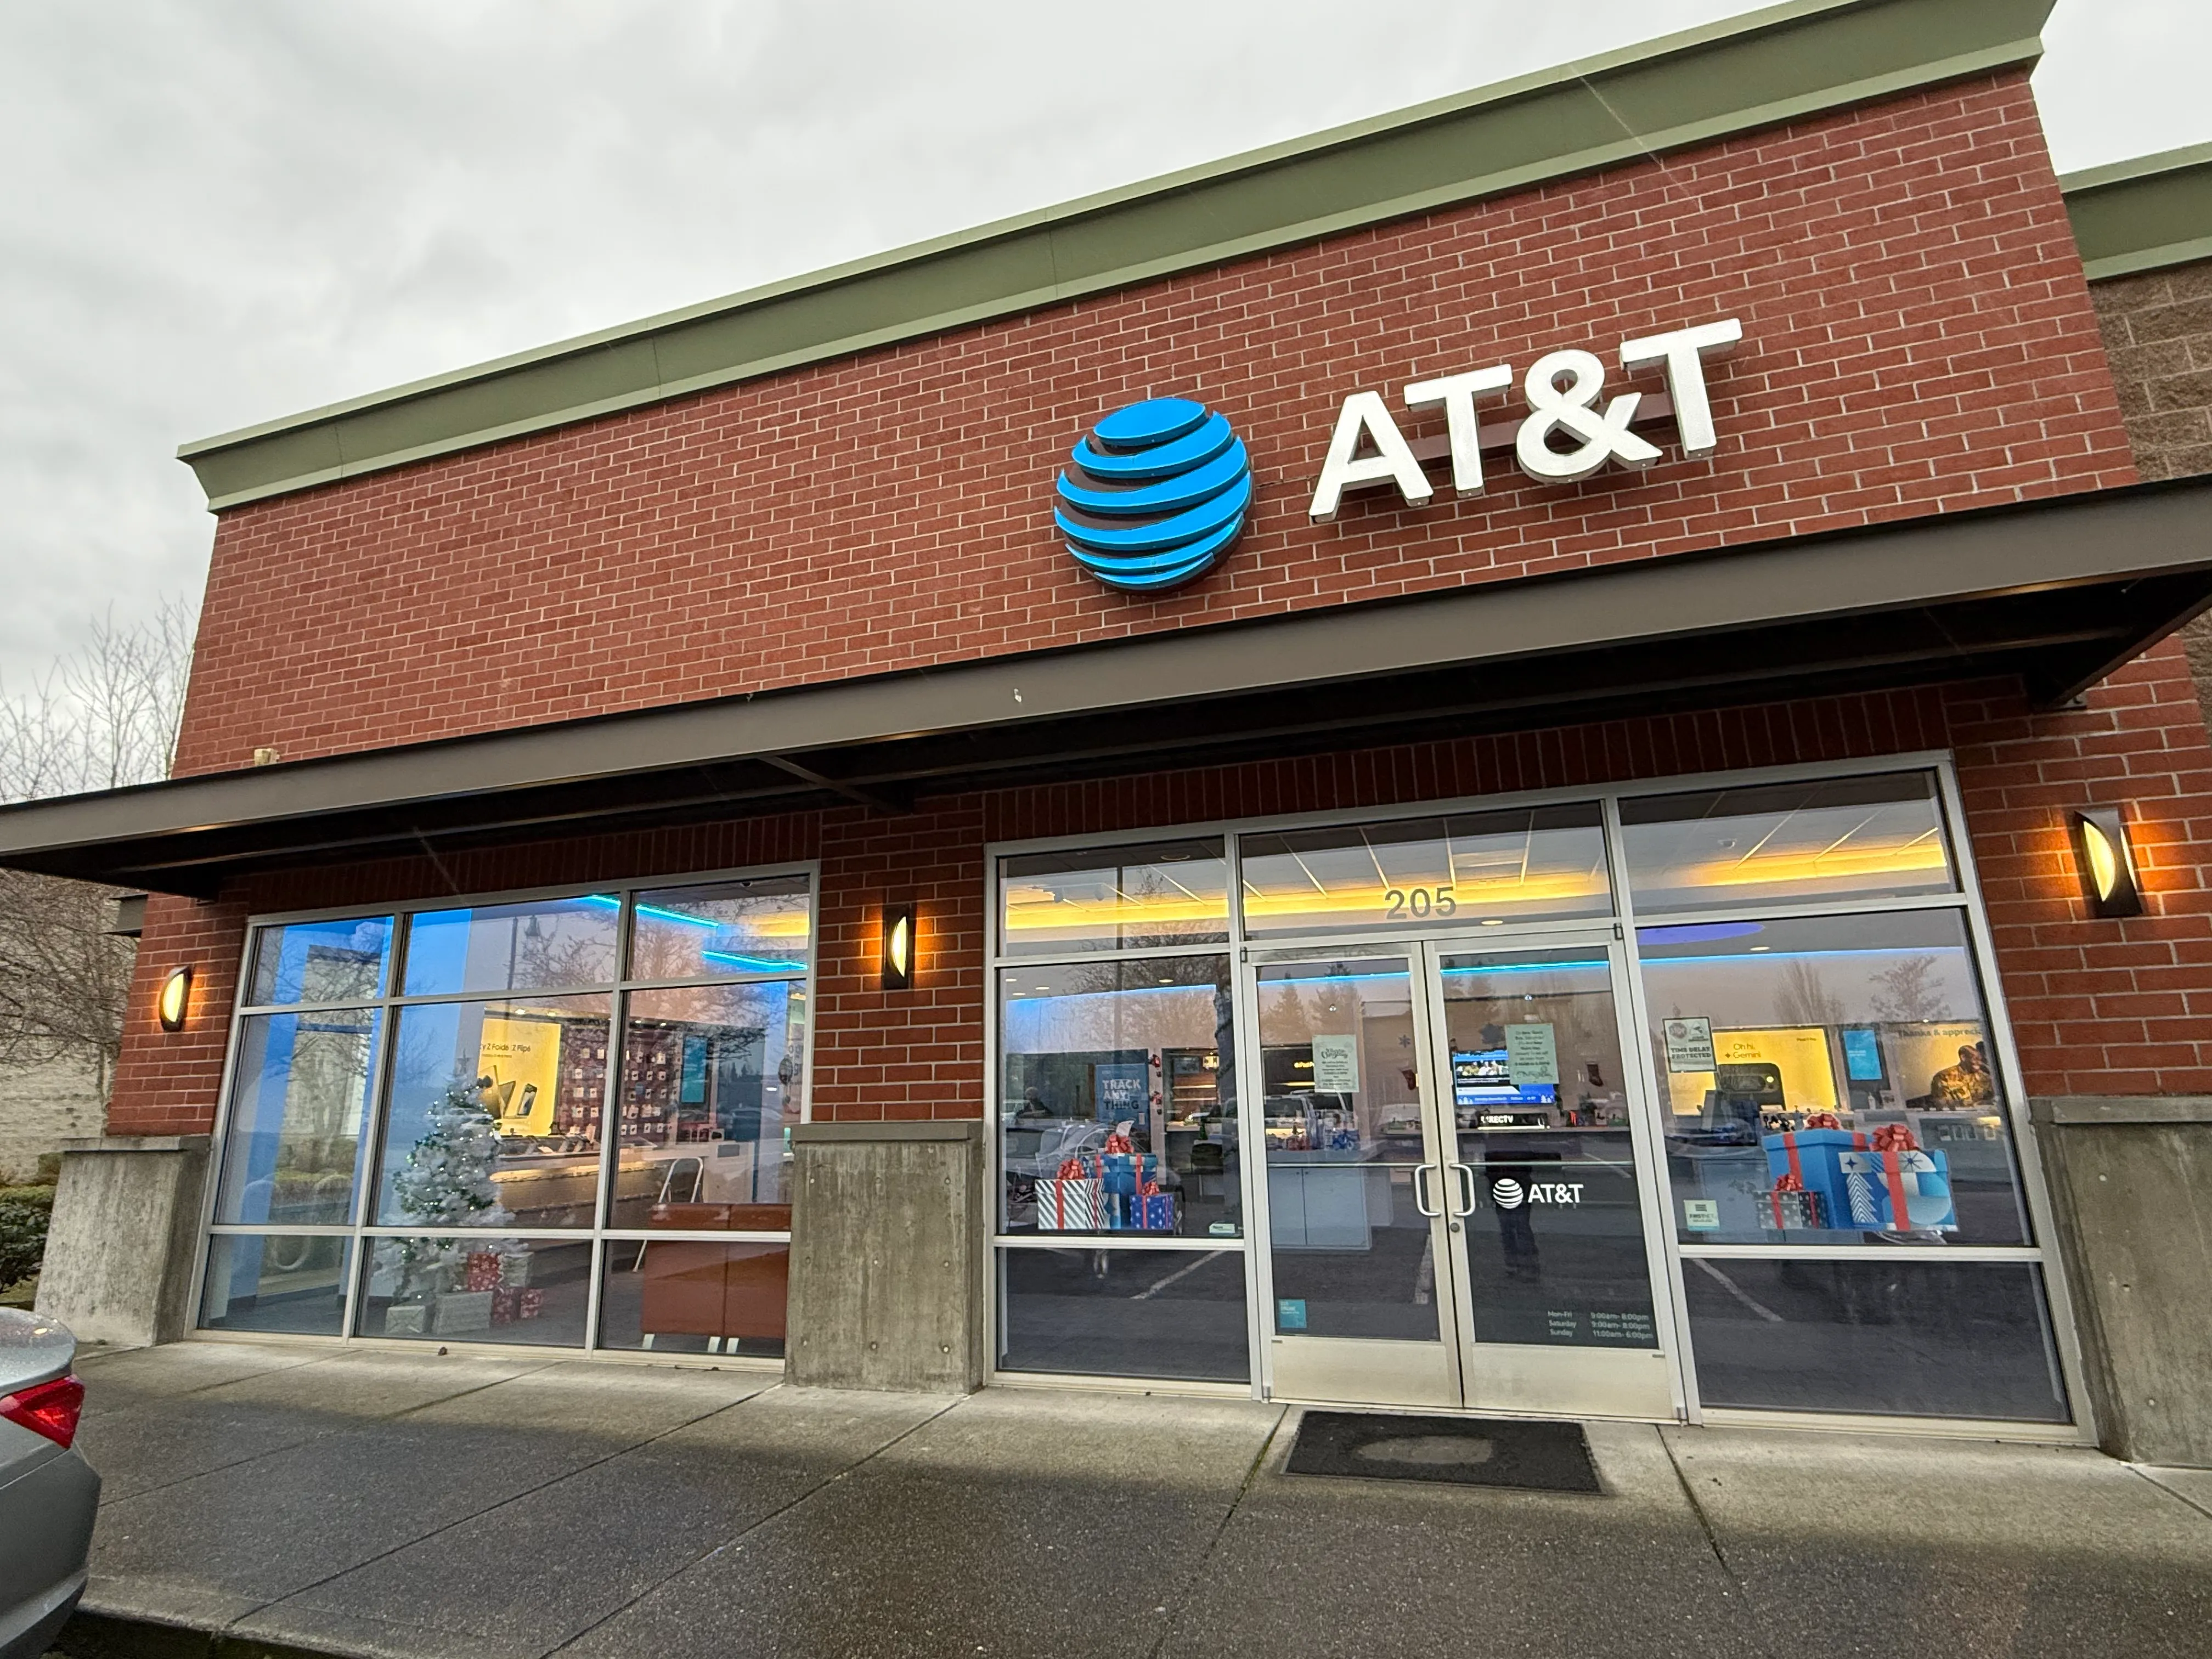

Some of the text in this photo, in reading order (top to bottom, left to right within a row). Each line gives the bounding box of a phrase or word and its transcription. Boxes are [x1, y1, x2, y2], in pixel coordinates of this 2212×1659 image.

[1309, 318, 1742, 522] AT&T
[1385, 886, 1456, 919] 205
[1102, 1079, 1141, 1090] TRACK
[1527, 1183, 1584, 1204] AT&T
[1547, 1310, 1572, 1318] Mon-Fri
[1549, 1319, 1577, 1328] Saturday
[1550, 1328, 1573, 1338] Sunday
[1626, 1331, 1654, 1340] 6:00pm
